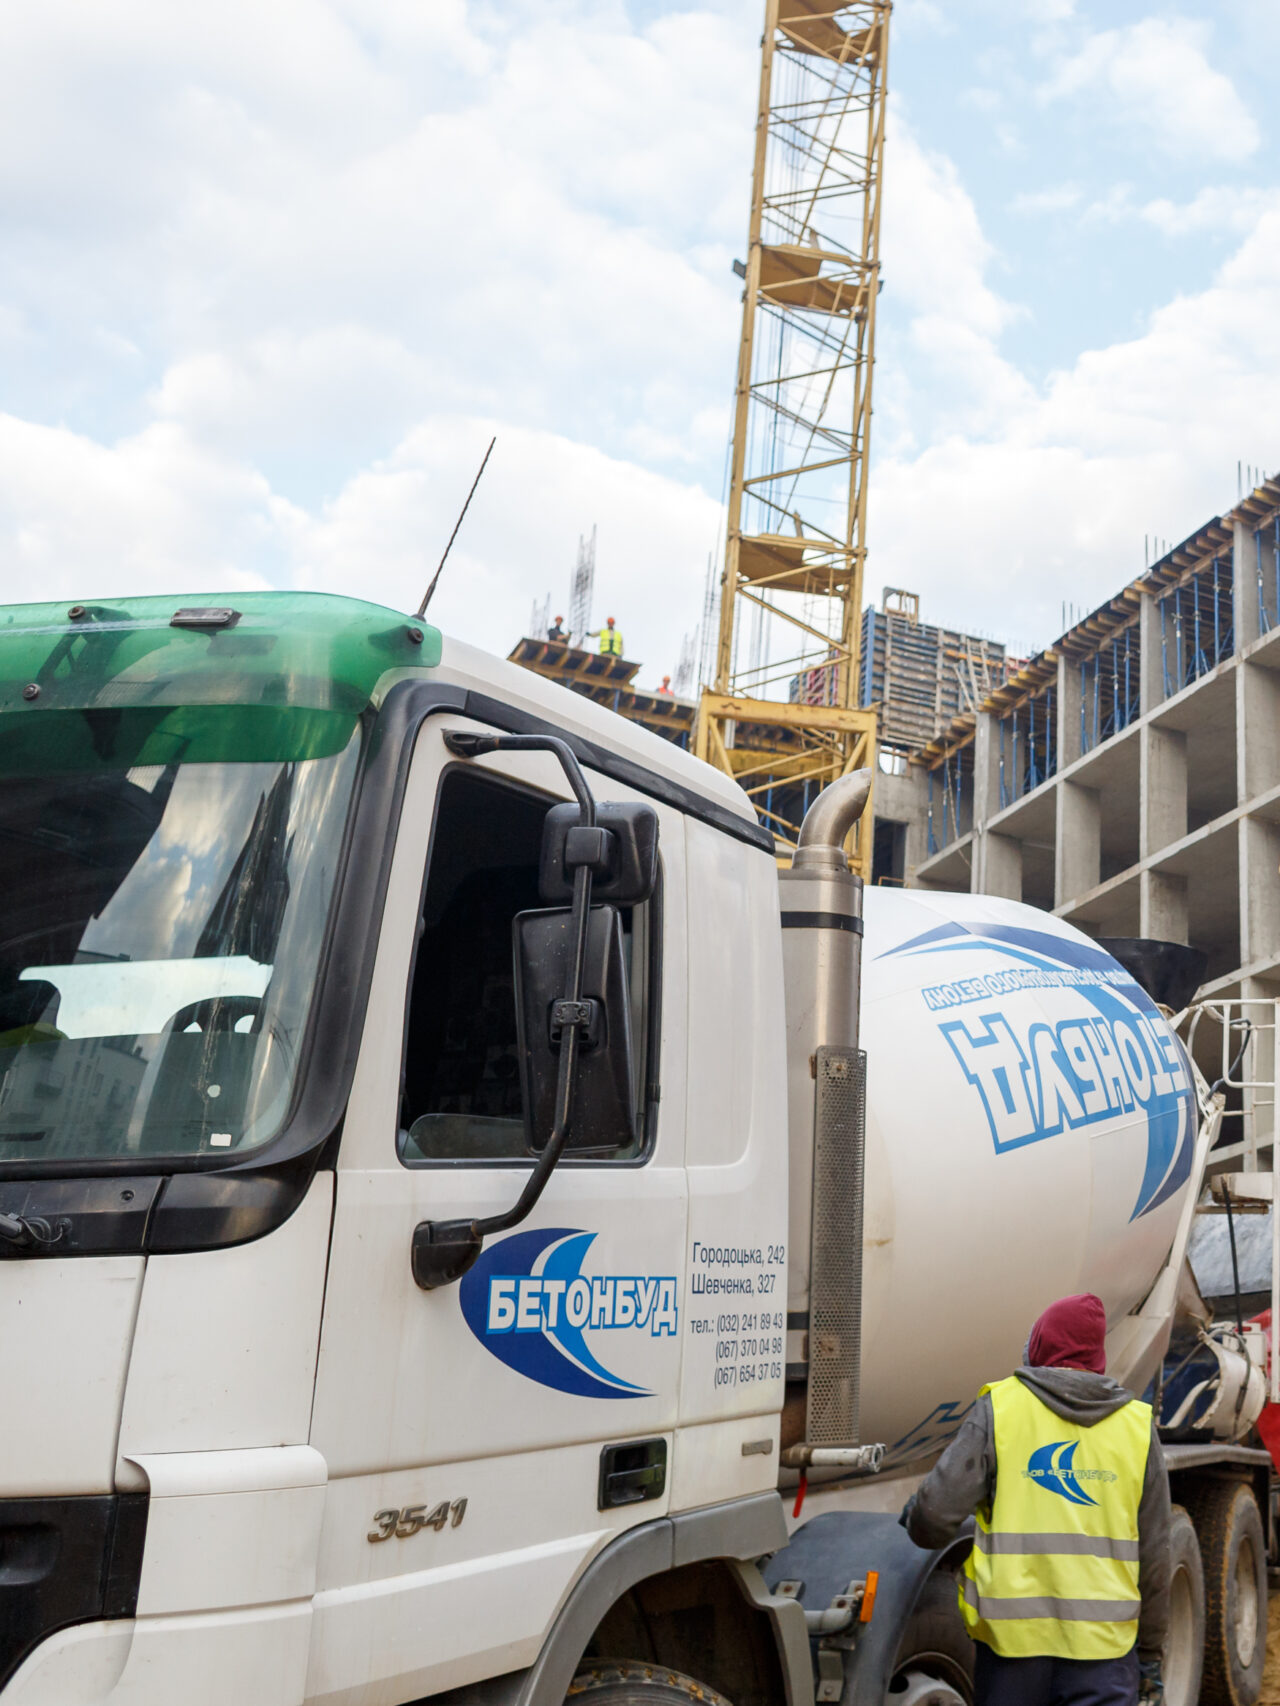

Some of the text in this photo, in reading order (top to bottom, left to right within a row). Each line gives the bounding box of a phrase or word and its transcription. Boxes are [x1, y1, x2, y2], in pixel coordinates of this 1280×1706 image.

[921, 978, 992, 1011] БЕТОНУ
[938, 1010, 1190, 1155] ЕТОНБУД
[693, 1242, 785, 1268] Городоцька, 242
[692, 1273, 776, 1297] Шевченка, 327
[486, 1275, 678, 1337] БЕТОНБУД
[690, 1312, 783, 1336] тел.: (032) 241 89 43
[715, 1337, 782, 1363] (067) 370 04 98
[714, 1362, 782, 1391] (067) 654 37 05
[368, 1496, 468, 1543] 3541
